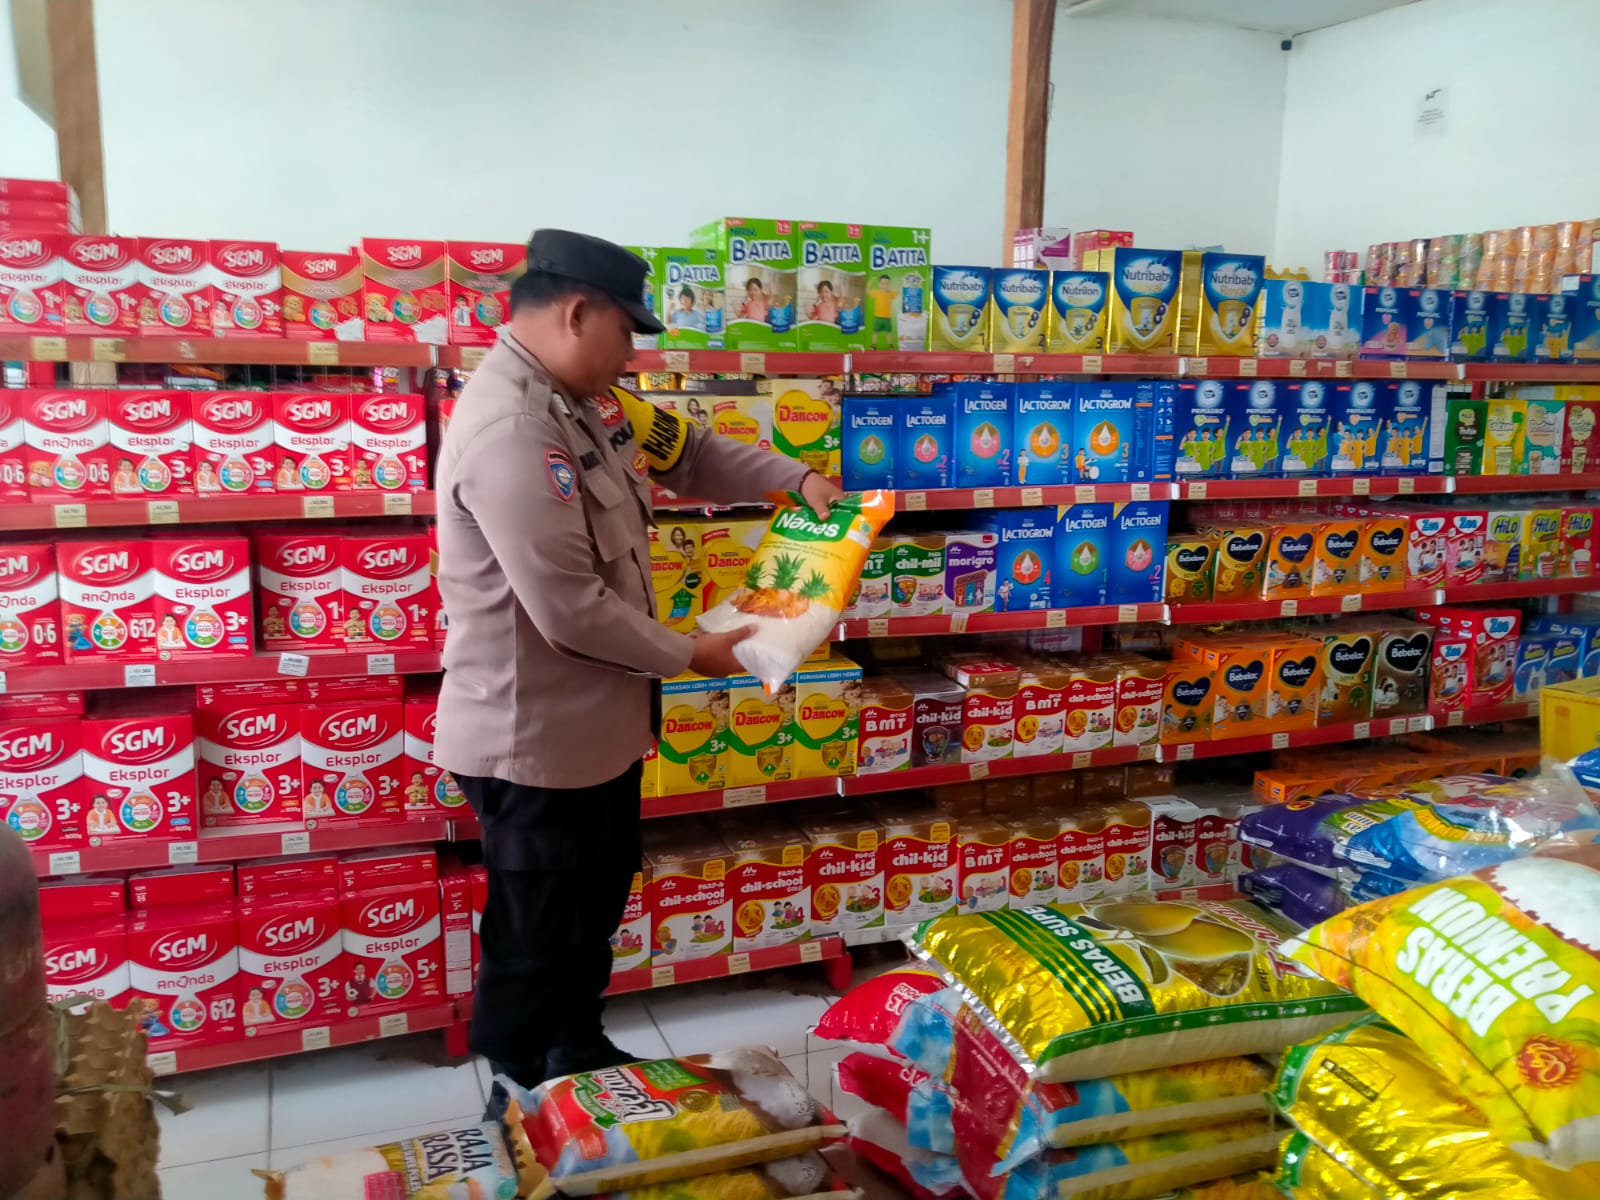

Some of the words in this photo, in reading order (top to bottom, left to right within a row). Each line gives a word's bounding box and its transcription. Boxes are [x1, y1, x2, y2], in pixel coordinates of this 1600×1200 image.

[2, 239, 42, 258] SGM
[76, 243, 119, 262] SGM
[152, 246, 192, 265] SGM
[387, 246, 421, 262] SGM
[471, 249, 503, 265] SGM
[732, 239, 791, 262] BATITA
[804, 242, 862, 265] BATITA
[224, 250, 263, 267] SGM
[305, 259, 337, 274] SGM
[871, 246, 928, 271] BATITA
[1122, 268, 1173, 284] Nutribaby
[940, 279, 985, 293] Nutribaby
[1000, 281, 1045, 296] Nutribaby
[1062, 284, 1099, 297] Nutrilon
[41, 399, 87, 421] SGM
[124, 399, 171, 421] SGM
[208, 400, 253, 421] SGM
[288, 400, 331, 421] SGM
[365, 402, 408, 422] SGM
[779, 405, 829, 423] Dancow
[964, 398, 1007, 414] LACTOGEN
[1019, 398, 1072, 415] LACTOGROW
[1080, 397, 1133, 412] LACTOGROW
[851, 414, 893, 428] LACTOGEN
[906, 413, 946, 428] LACTOGEN
[128, 436, 175, 448] Eksplor
[209, 437, 260, 449] Eksplor
[290, 435, 335, 447] Eksplor
[366, 437, 413, 449] Eksplor
[823, 434, 841, 448] 3+
[171, 459, 193, 478] 3+
[252, 456, 275, 476] 3+
[329, 458, 350, 476] 3+
[405, 455, 427, 473] 1+
[776, 512, 841, 538] Nanas
[1065, 516, 1107, 532] LACTOGEN
[1121, 514, 1161, 529] LACTOGEN
[1002, 526, 1054, 543] LACTOGROW
[80, 551, 129, 575] SGM
[176, 549, 224, 572] SGM
[282, 545, 326, 566] SGM
[363, 547, 407, 569] SGM
[948, 555, 994, 569] morigro
[0, 554, 29, 577] GM
[175, 587, 231, 599] Eksplor
[280, 581, 332, 593] Eksplor
[361, 583, 413, 595] Eksplor
[225, 611, 248, 631] 3+
[407, 603, 428, 622] 1+
[735, 711, 781, 726] Dancow
[801, 706, 847, 721] Dancow
[226, 714, 276, 739] SGM
[328, 714, 377, 741] SGM
[665, 718, 713, 734] Dancow
[842, 727, 857, 739] 3+
[0, 732, 52, 761] SGM
[111, 726, 165, 755] SGM
[710, 740, 727, 751] 3+
[777, 732, 793, 744] 3+
[224, 752, 281, 765] Eksplor
[326, 752, 382, 767] Eksplor
[0, 774, 59, 790] Eksplor
[109, 768, 170, 782] Eksplor
[278, 775, 300, 795] 3+
[378, 775, 400, 795] 3+
[56, 798, 81, 820] 3+
[166, 791, 191, 813] 3+
[367, 899, 415, 928] SGM
[1022, 905, 1080, 939] SUPE
[264, 917, 315, 948] SGM
[158, 934, 207, 962] SGM
[365, 937, 420, 954] Eksplor
[46, 948, 97, 975] SGM
[263, 955, 321, 973] Eksplor
[1408, 886, 1596, 1025] PREMIUM
[416, 959, 439, 979] 5+
[1070, 937, 1146, 1004] BERAS
[318, 977, 340, 998] 3+
[1396, 926, 1519, 1038] BERAS
[419, 1132, 459, 1179] RASA
[451, 1128, 493, 1174] RAJA
